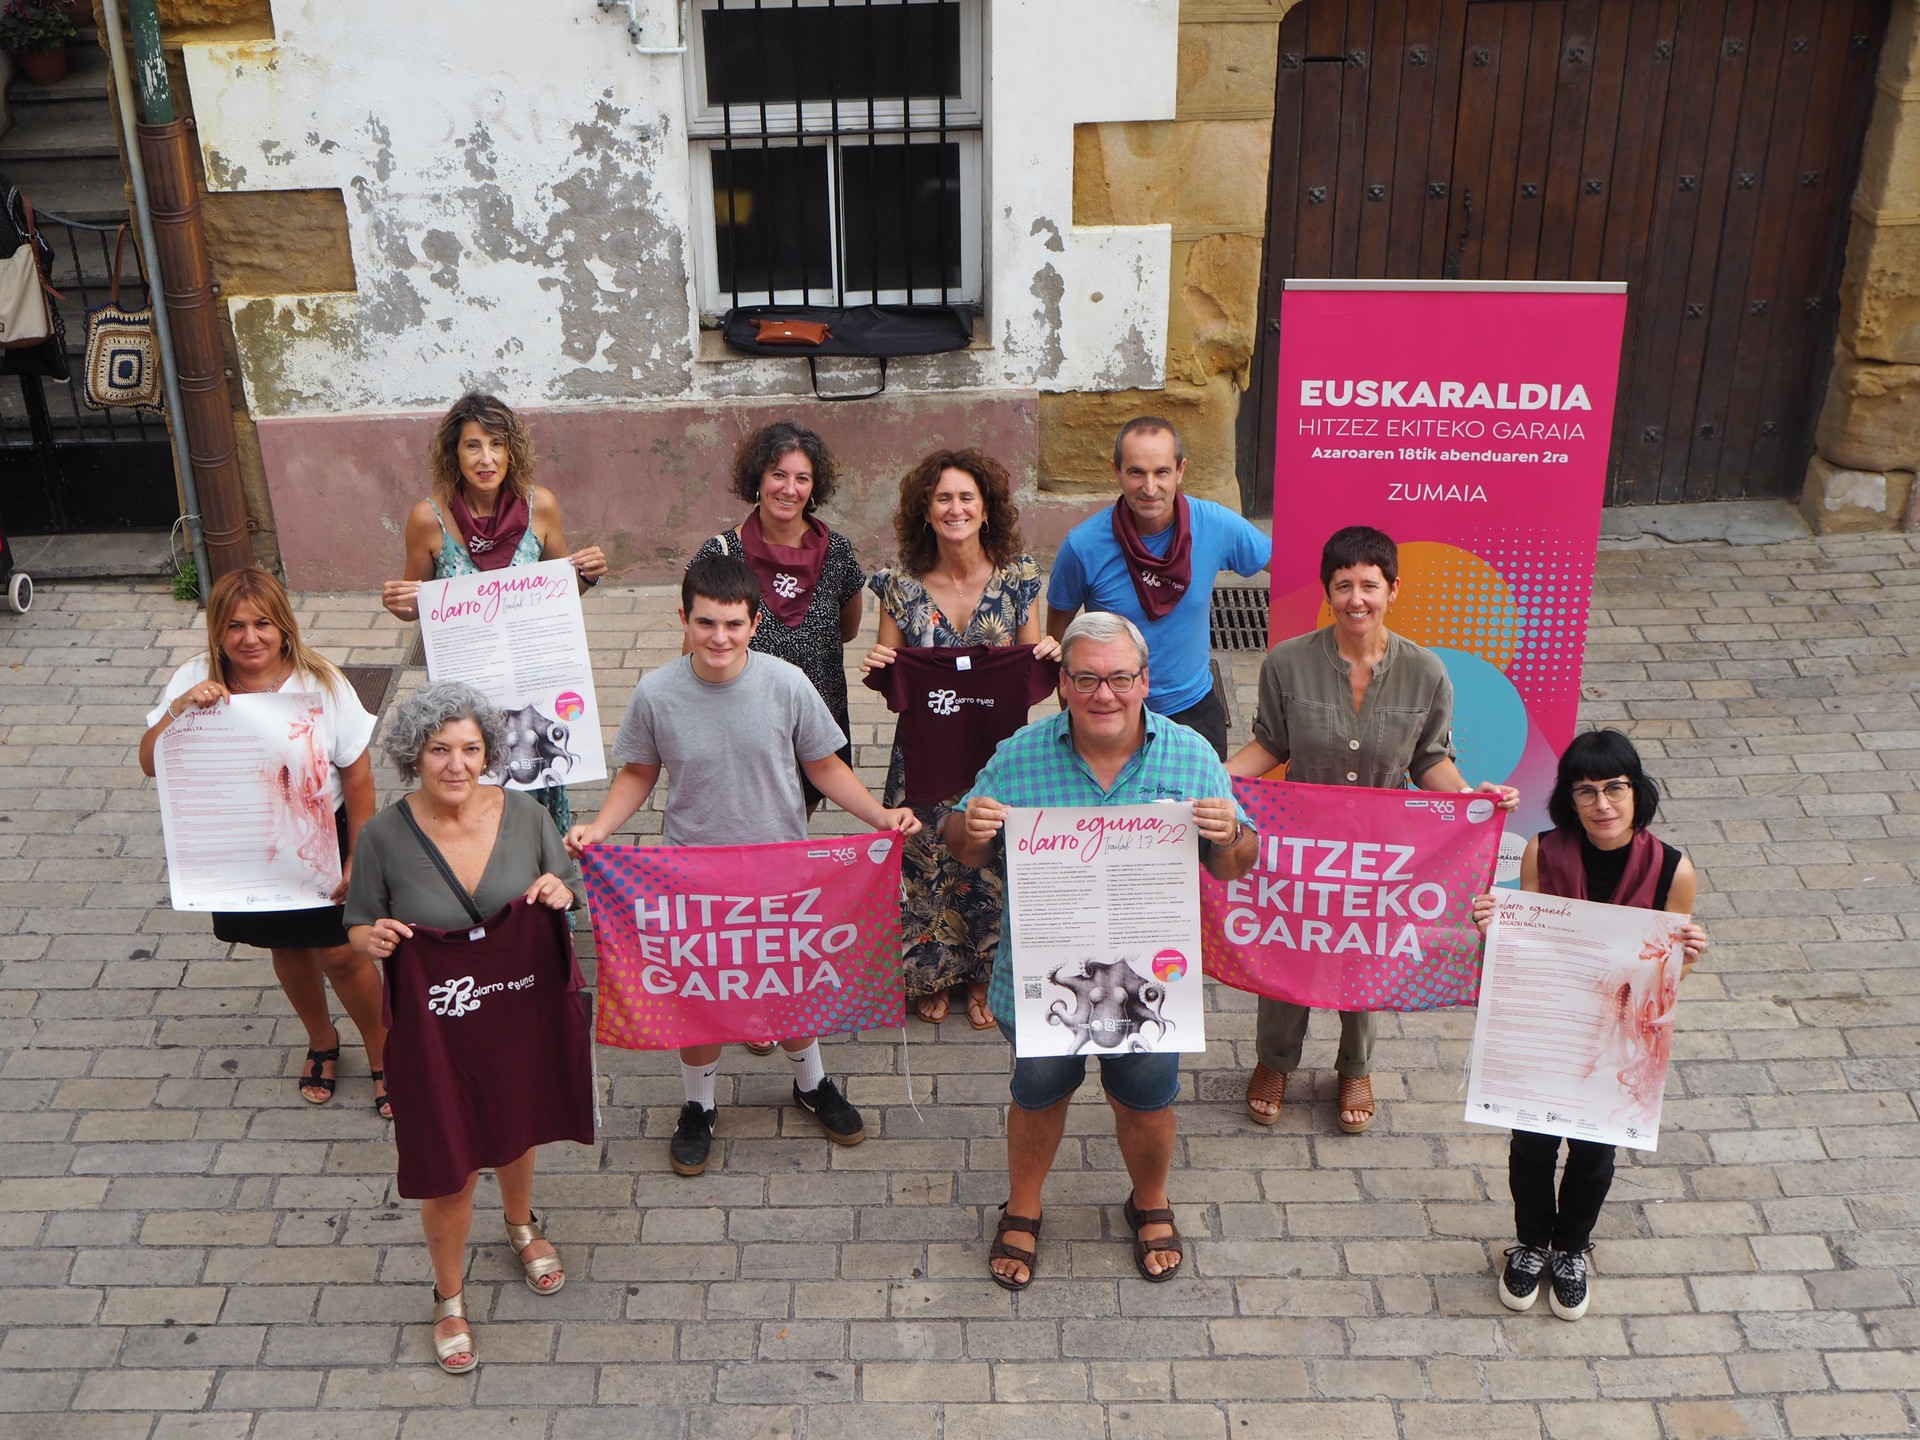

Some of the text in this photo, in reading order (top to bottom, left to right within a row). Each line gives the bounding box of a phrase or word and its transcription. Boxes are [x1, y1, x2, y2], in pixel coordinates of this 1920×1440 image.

[1300, 380, 1592, 410] EUSKARALDIA
[1299, 418, 1585, 440] HITZEZ EKITEKO GARAIA
[1311, 446, 1568, 463] Azaroaren 18tik abenduaren 2ra
[1387, 483, 1487, 503] ZUMAIA
[431, 574, 568, 624] olarro eguna 22
[530, 593, 542, 608] 17
[1430, 801, 1455, 813] 365
[1018, 810, 1187, 863] olarro eguna 22
[1137, 835, 1153, 850] 17
[831, 847, 857, 863] 365
[1227, 873, 1447, 920] EKITEKO
[1499, 894, 1572, 922] olarro eguneko
[635, 887, 823, 931] HITZEZ
[1499, 911, 1517, 920] XVI.
[1224, 908, 1424, 962] GARAIA
[1498, 919, 1546, 929] ARGAZKI RALLYA
[638, 923, 857, 967] EKITEKO
[472, 974, 535, 998] olarro eguna
[641, 960, 842, 1001] GARAIA
